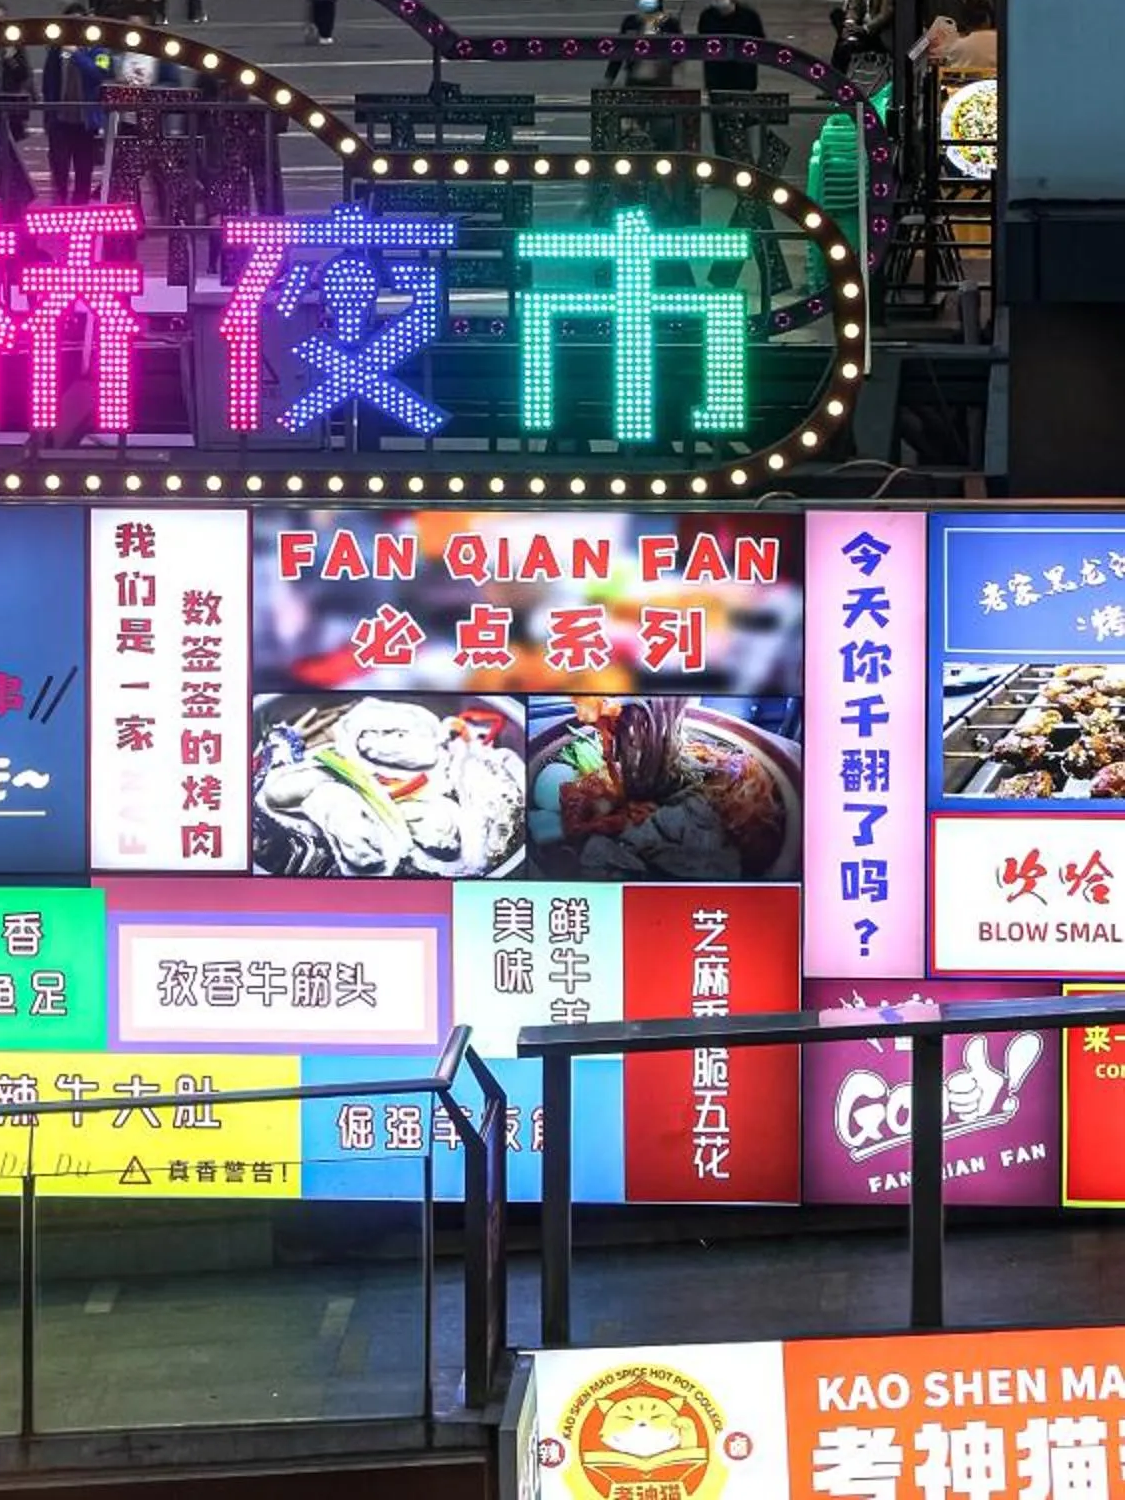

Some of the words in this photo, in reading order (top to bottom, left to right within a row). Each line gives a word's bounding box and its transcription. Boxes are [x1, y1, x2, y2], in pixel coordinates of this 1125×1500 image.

[278, 531, 418, 581] FAN
[444, 532, 612, 586] QIAN
[638, 531, 780, 584] FAN
[114, 522, 157, 751] 我们是一家
[351, 604, 707, 672] 必点系列
[181, 589, 223, 859] 数签签的烤肉
[492, 897, 535, 994] 美味
[978, 921, 1049, 944] BLOW
[157, 959, 379, 1009] 孜香牛筋头
[941, 1155, 986, 1182] IAN
[999, 1142, 1046, 1167] FAN
[818, 1374, 911, 1412] KAO
[922, 1370, 1047, 1408] SHEN
